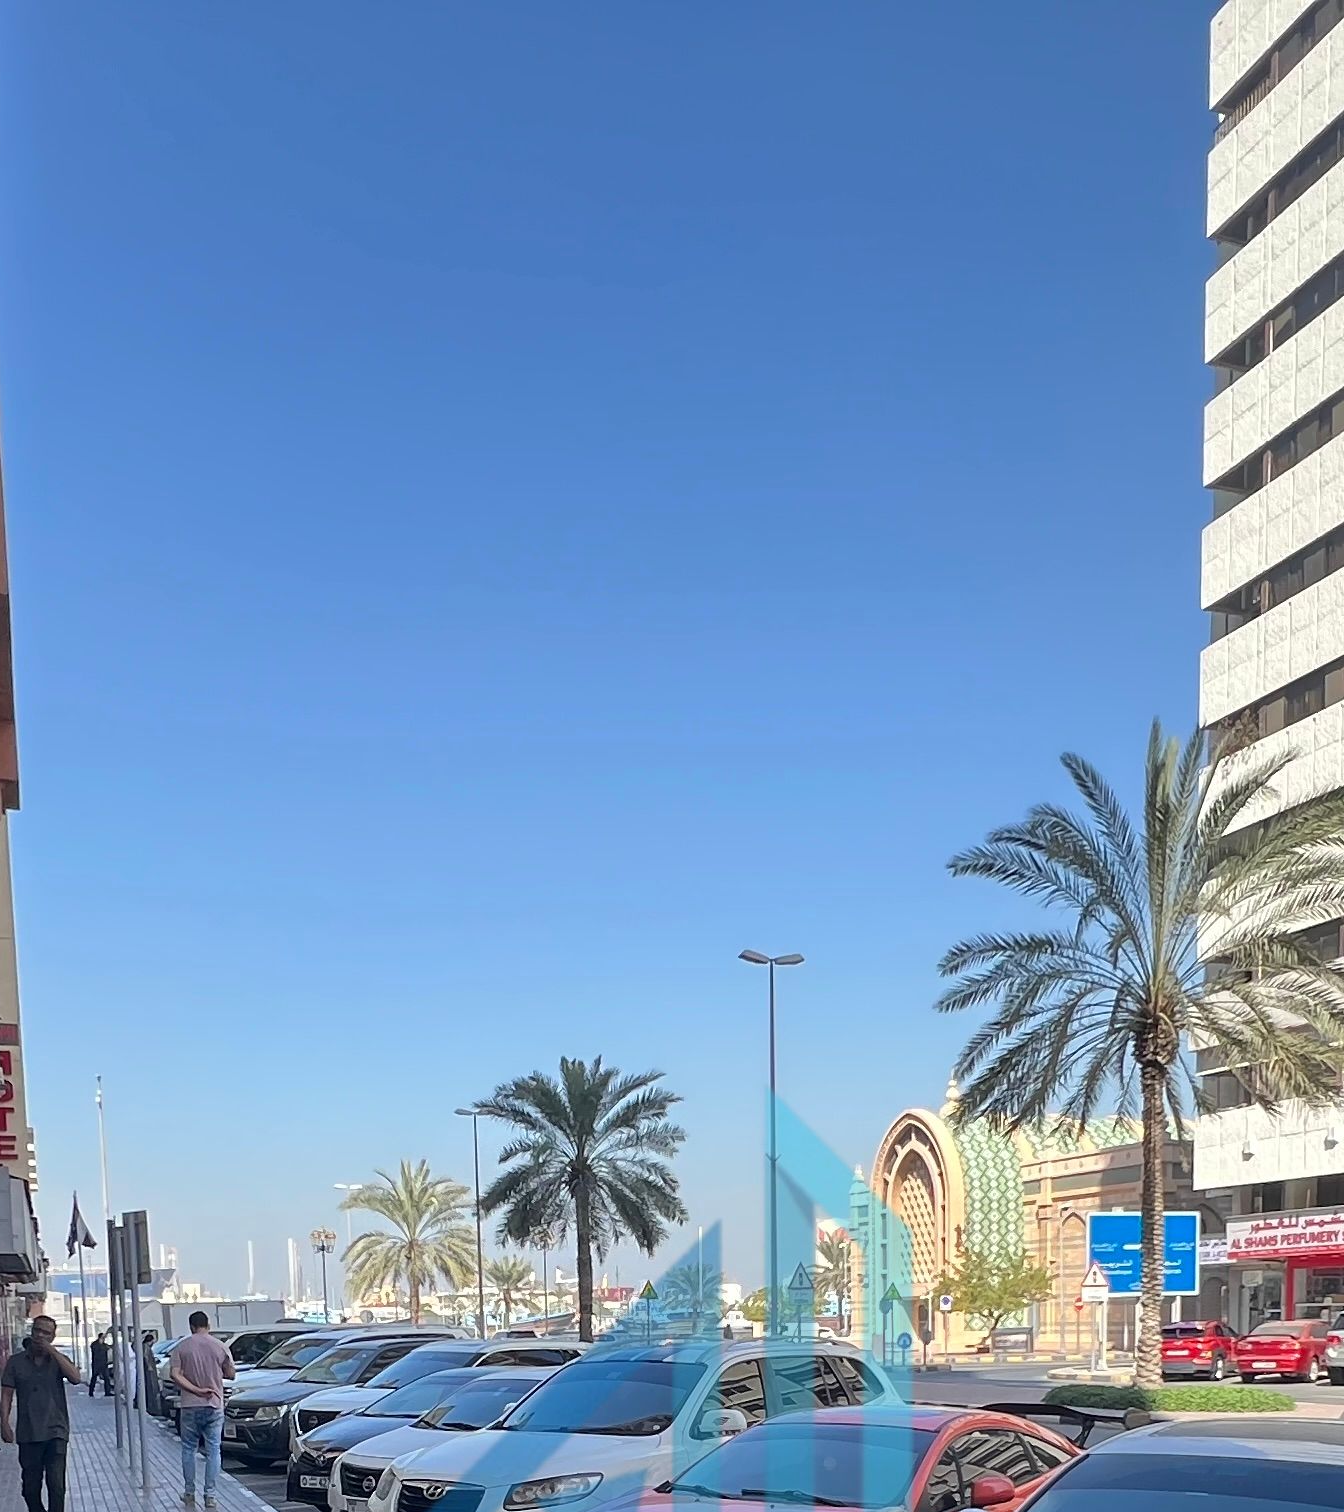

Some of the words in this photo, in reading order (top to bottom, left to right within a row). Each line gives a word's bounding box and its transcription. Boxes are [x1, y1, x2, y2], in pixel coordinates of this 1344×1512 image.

[1231, 1239, 1242, 1250] AL
[1244, 1235, 1278, 1248] SHAMS
[1280, 1229, 1340, 1245] PERFUMERY
